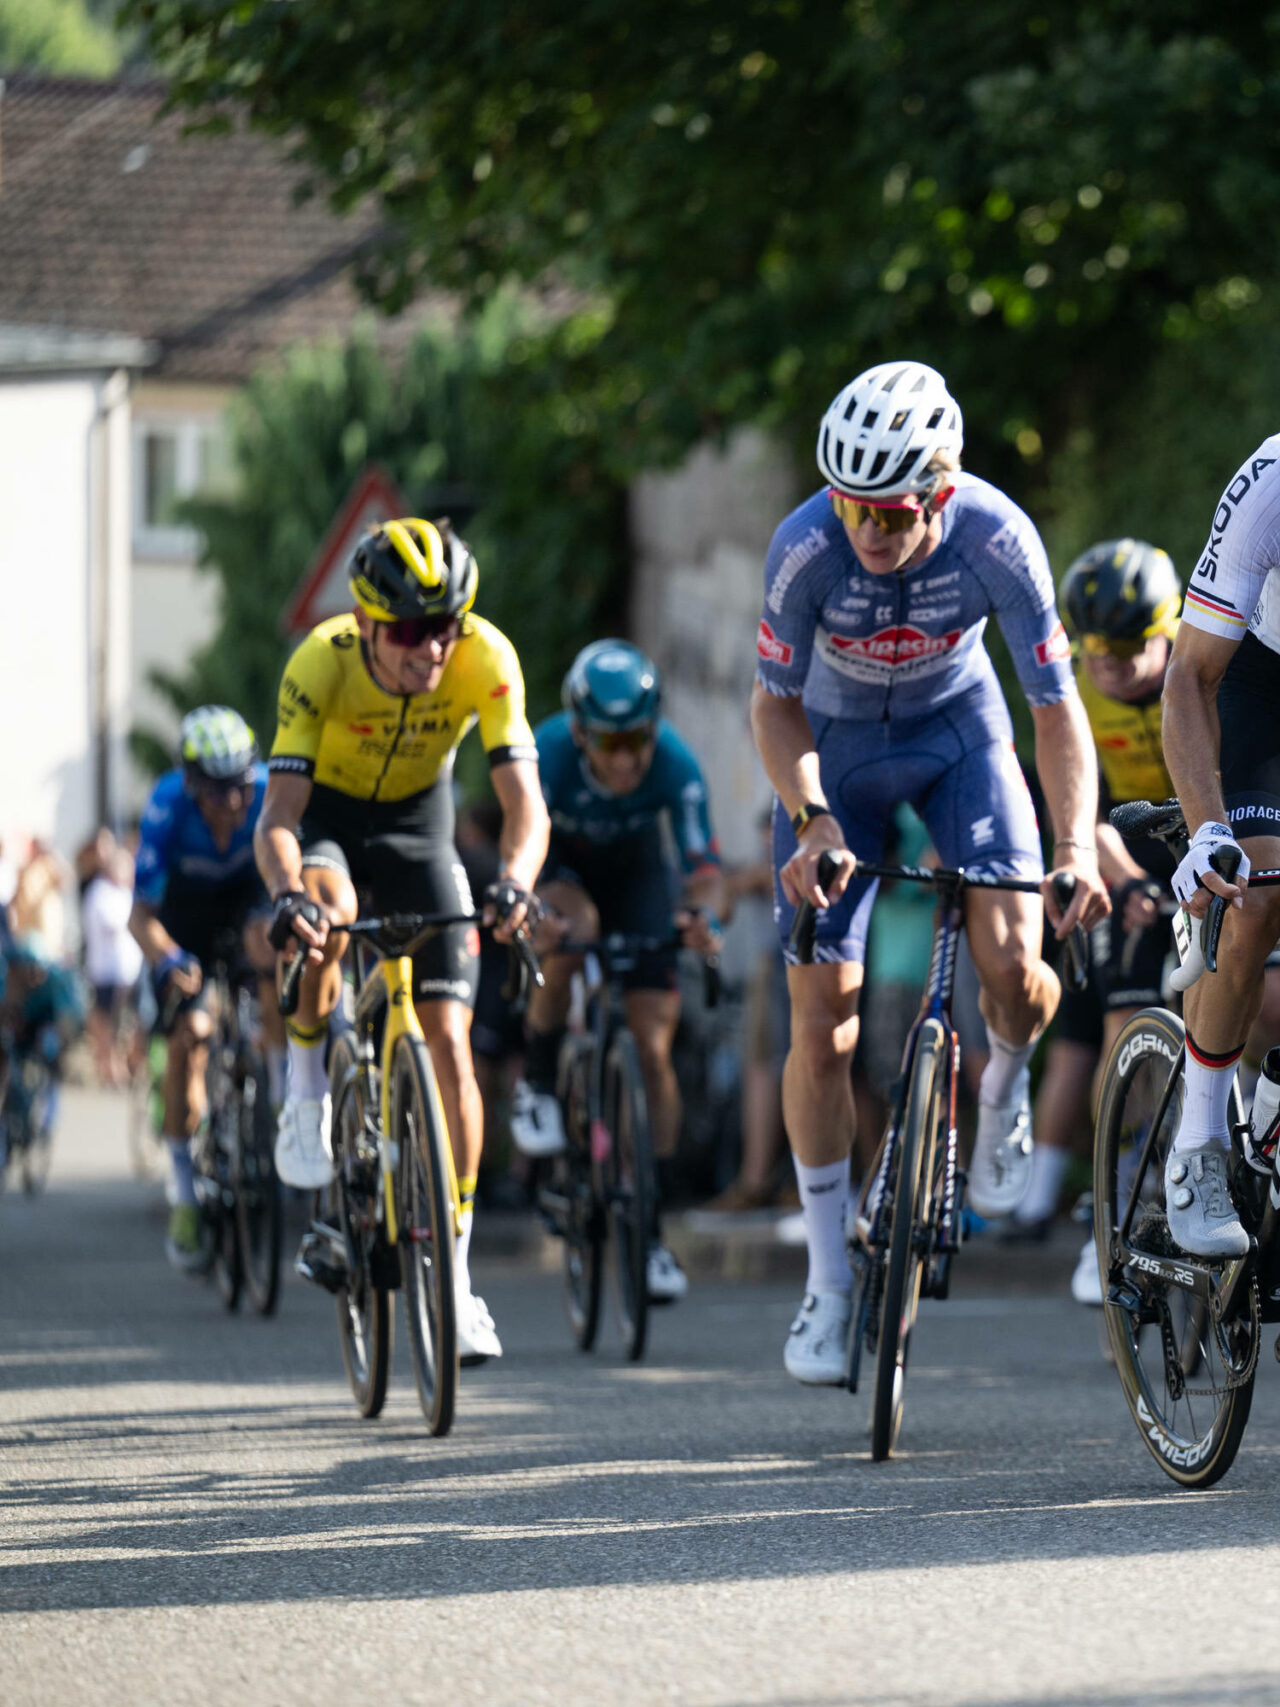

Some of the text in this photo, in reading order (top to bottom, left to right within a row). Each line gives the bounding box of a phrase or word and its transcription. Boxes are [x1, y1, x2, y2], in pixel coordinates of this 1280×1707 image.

[843, 639, 949, 658] Alpecin
[1118, 1033, 1180, 1078] CORIM
[1127, 1252, 1161, 1275] 795
[1137, 1393, 1214, 1467] CORIMA
